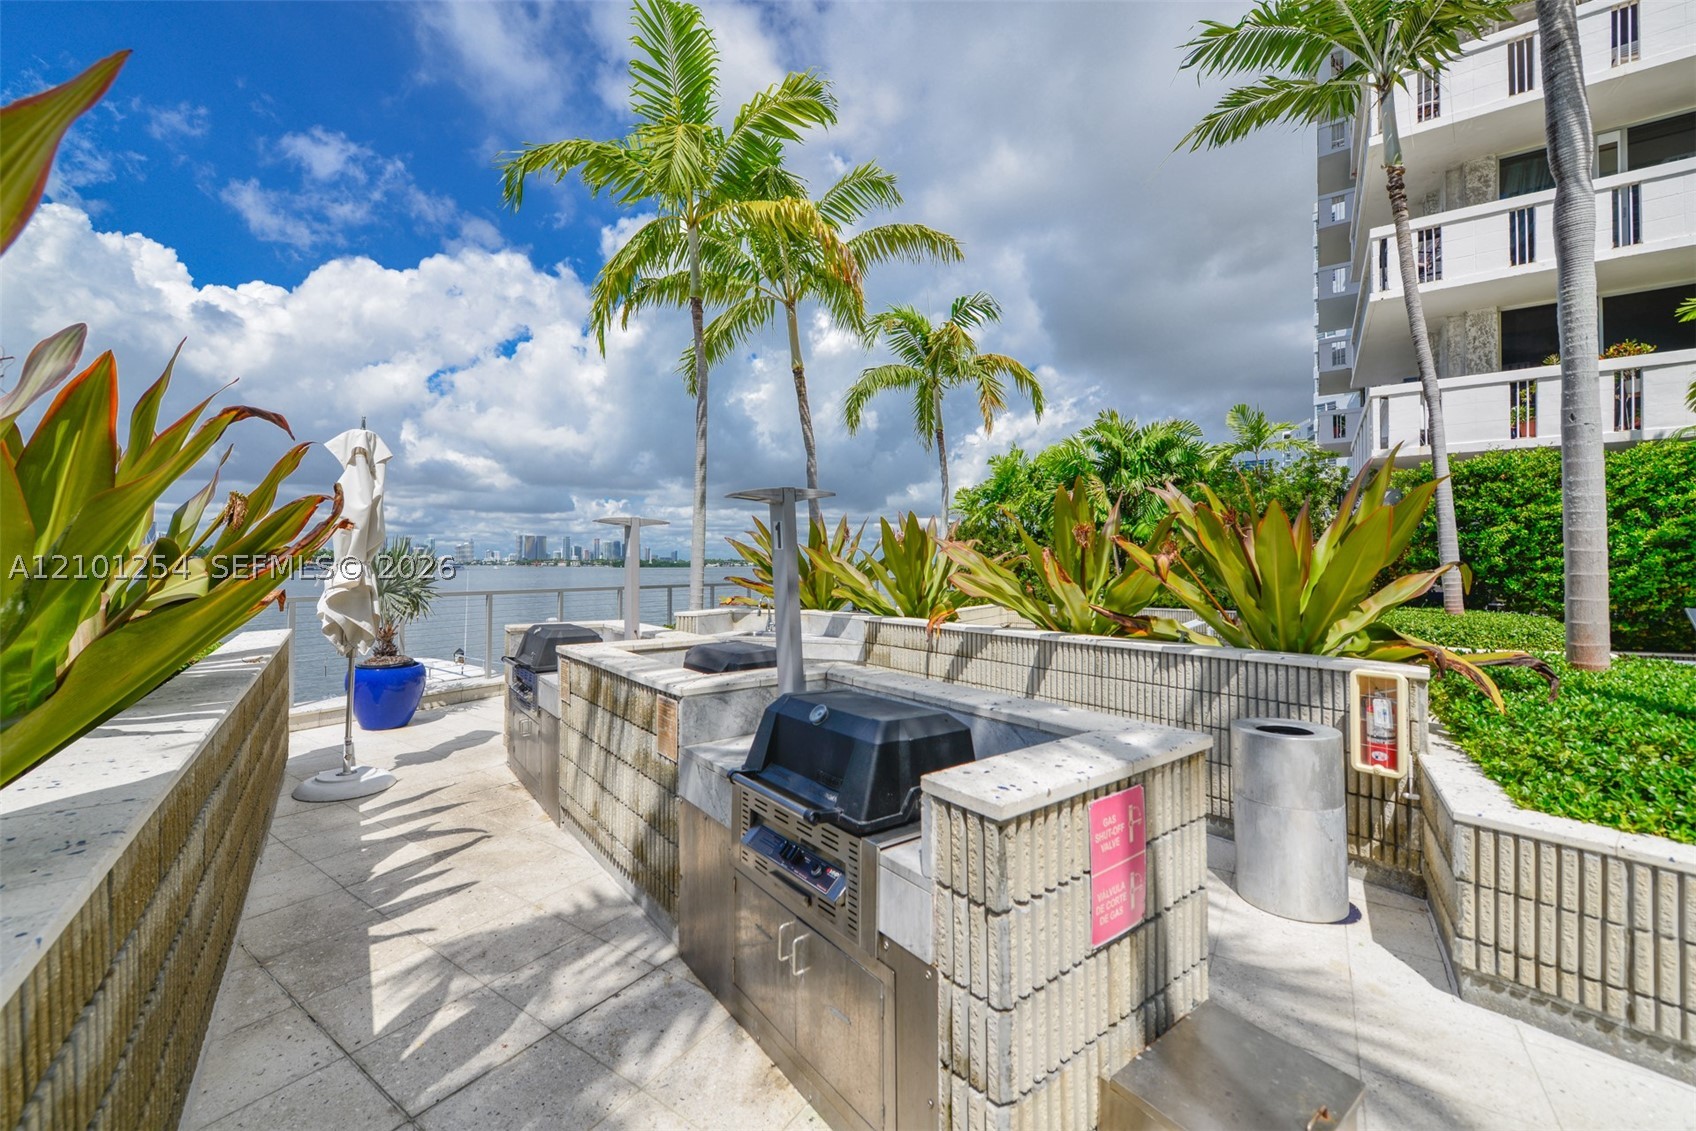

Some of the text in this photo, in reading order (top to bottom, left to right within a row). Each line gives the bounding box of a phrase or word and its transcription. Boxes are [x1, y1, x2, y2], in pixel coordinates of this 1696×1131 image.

[775, 522, 781, 548] 1
[1103, 815, 1116, 827] GAS
[1095, 823, 1125, 843] SHUT-OFF
[1101, 837, 1120, 853] VALVE
[1096, 892, 1127, 916] DE CORTE
[1100, 906, 1123, 926] DE GAS
